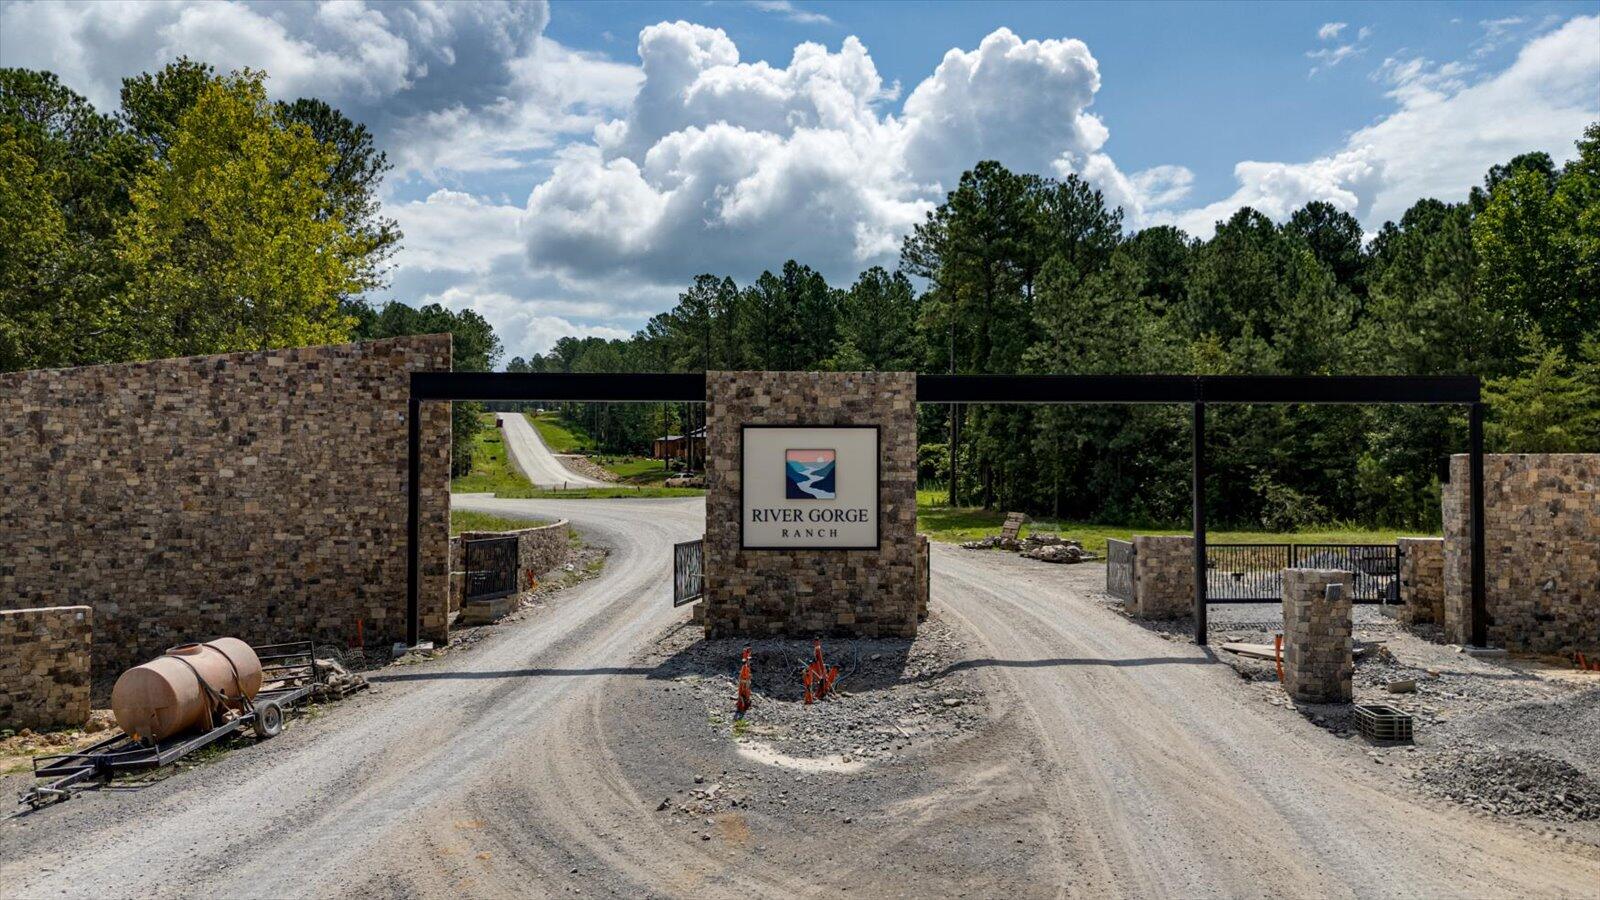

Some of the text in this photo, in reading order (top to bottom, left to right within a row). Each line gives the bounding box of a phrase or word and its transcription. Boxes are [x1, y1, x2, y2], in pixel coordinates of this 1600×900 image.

[752, 508, 869, 522] RIVER GORGE
[782, 529, 838, 538] RANCH
